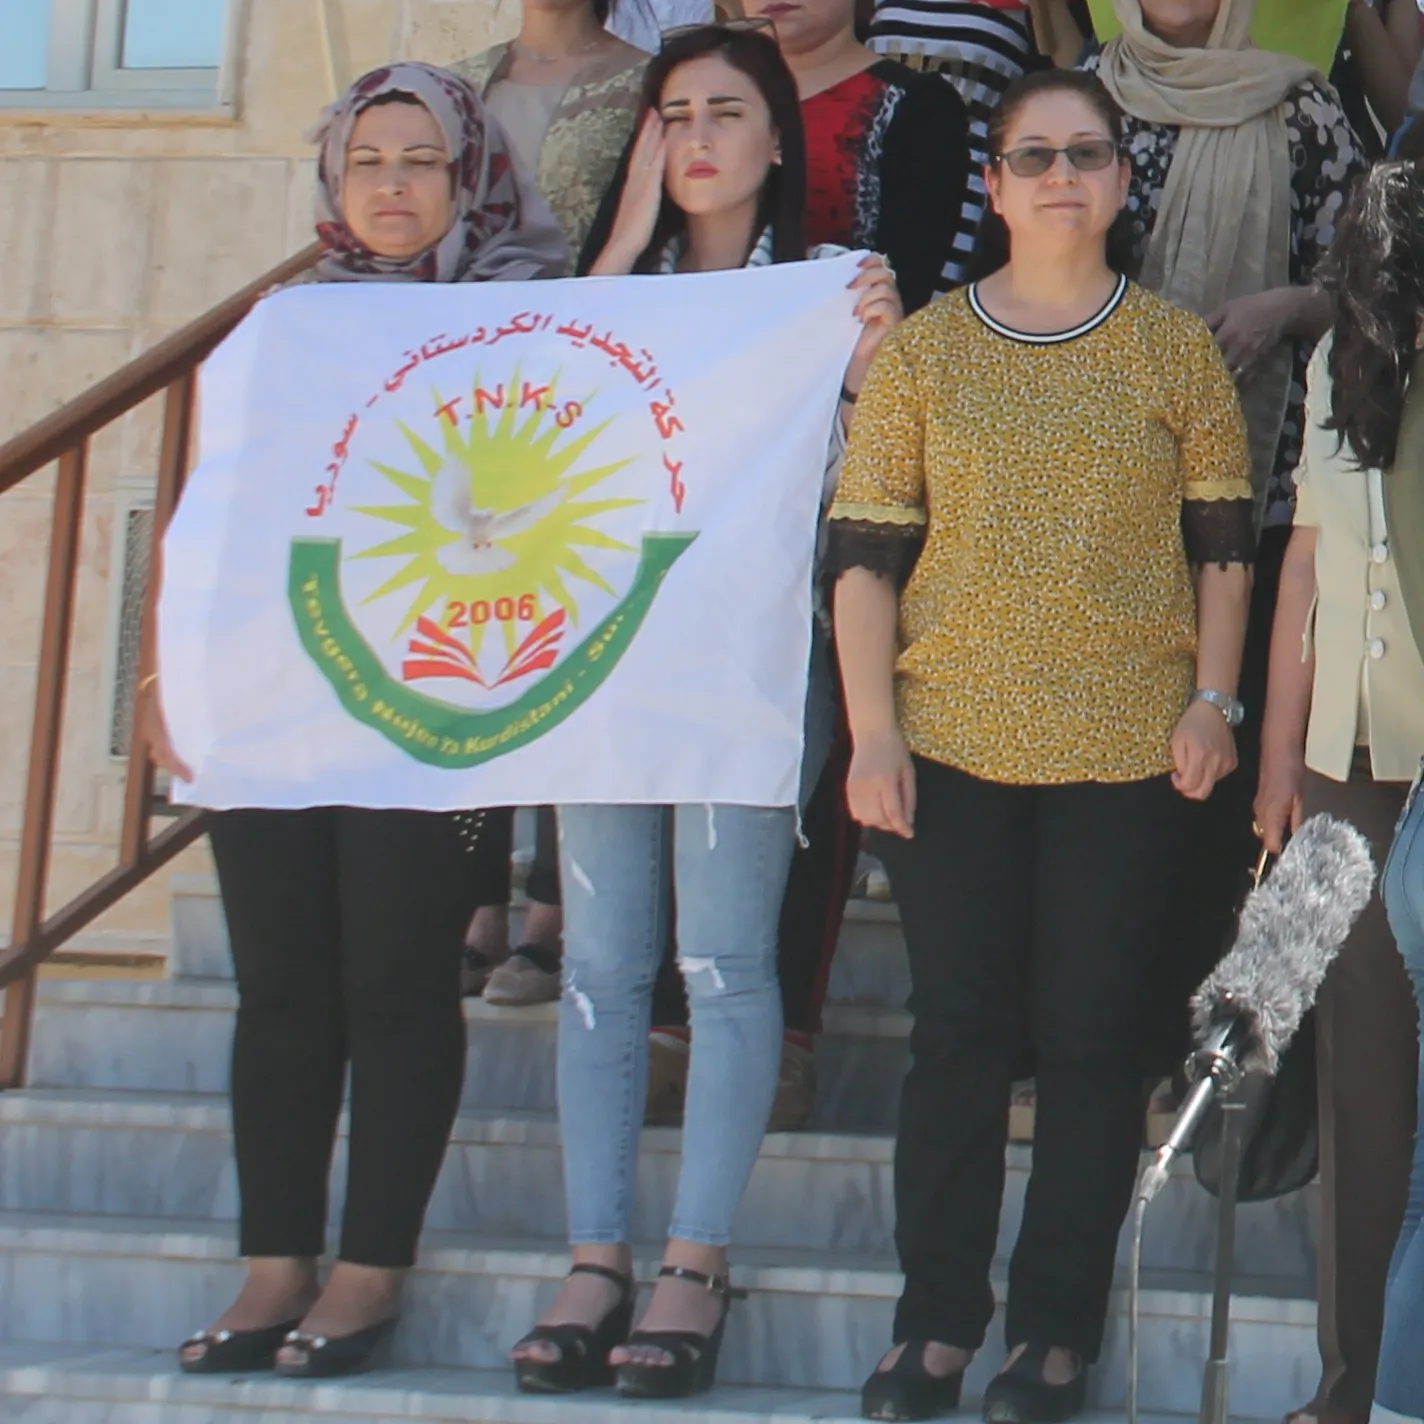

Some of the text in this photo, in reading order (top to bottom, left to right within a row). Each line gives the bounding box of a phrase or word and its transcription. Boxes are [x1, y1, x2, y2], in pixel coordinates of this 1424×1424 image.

[383, 311, 553, 393] الكردستاني
[555, 318, 663, 392] التجديد
[447, 592, 537, 628] 2006
